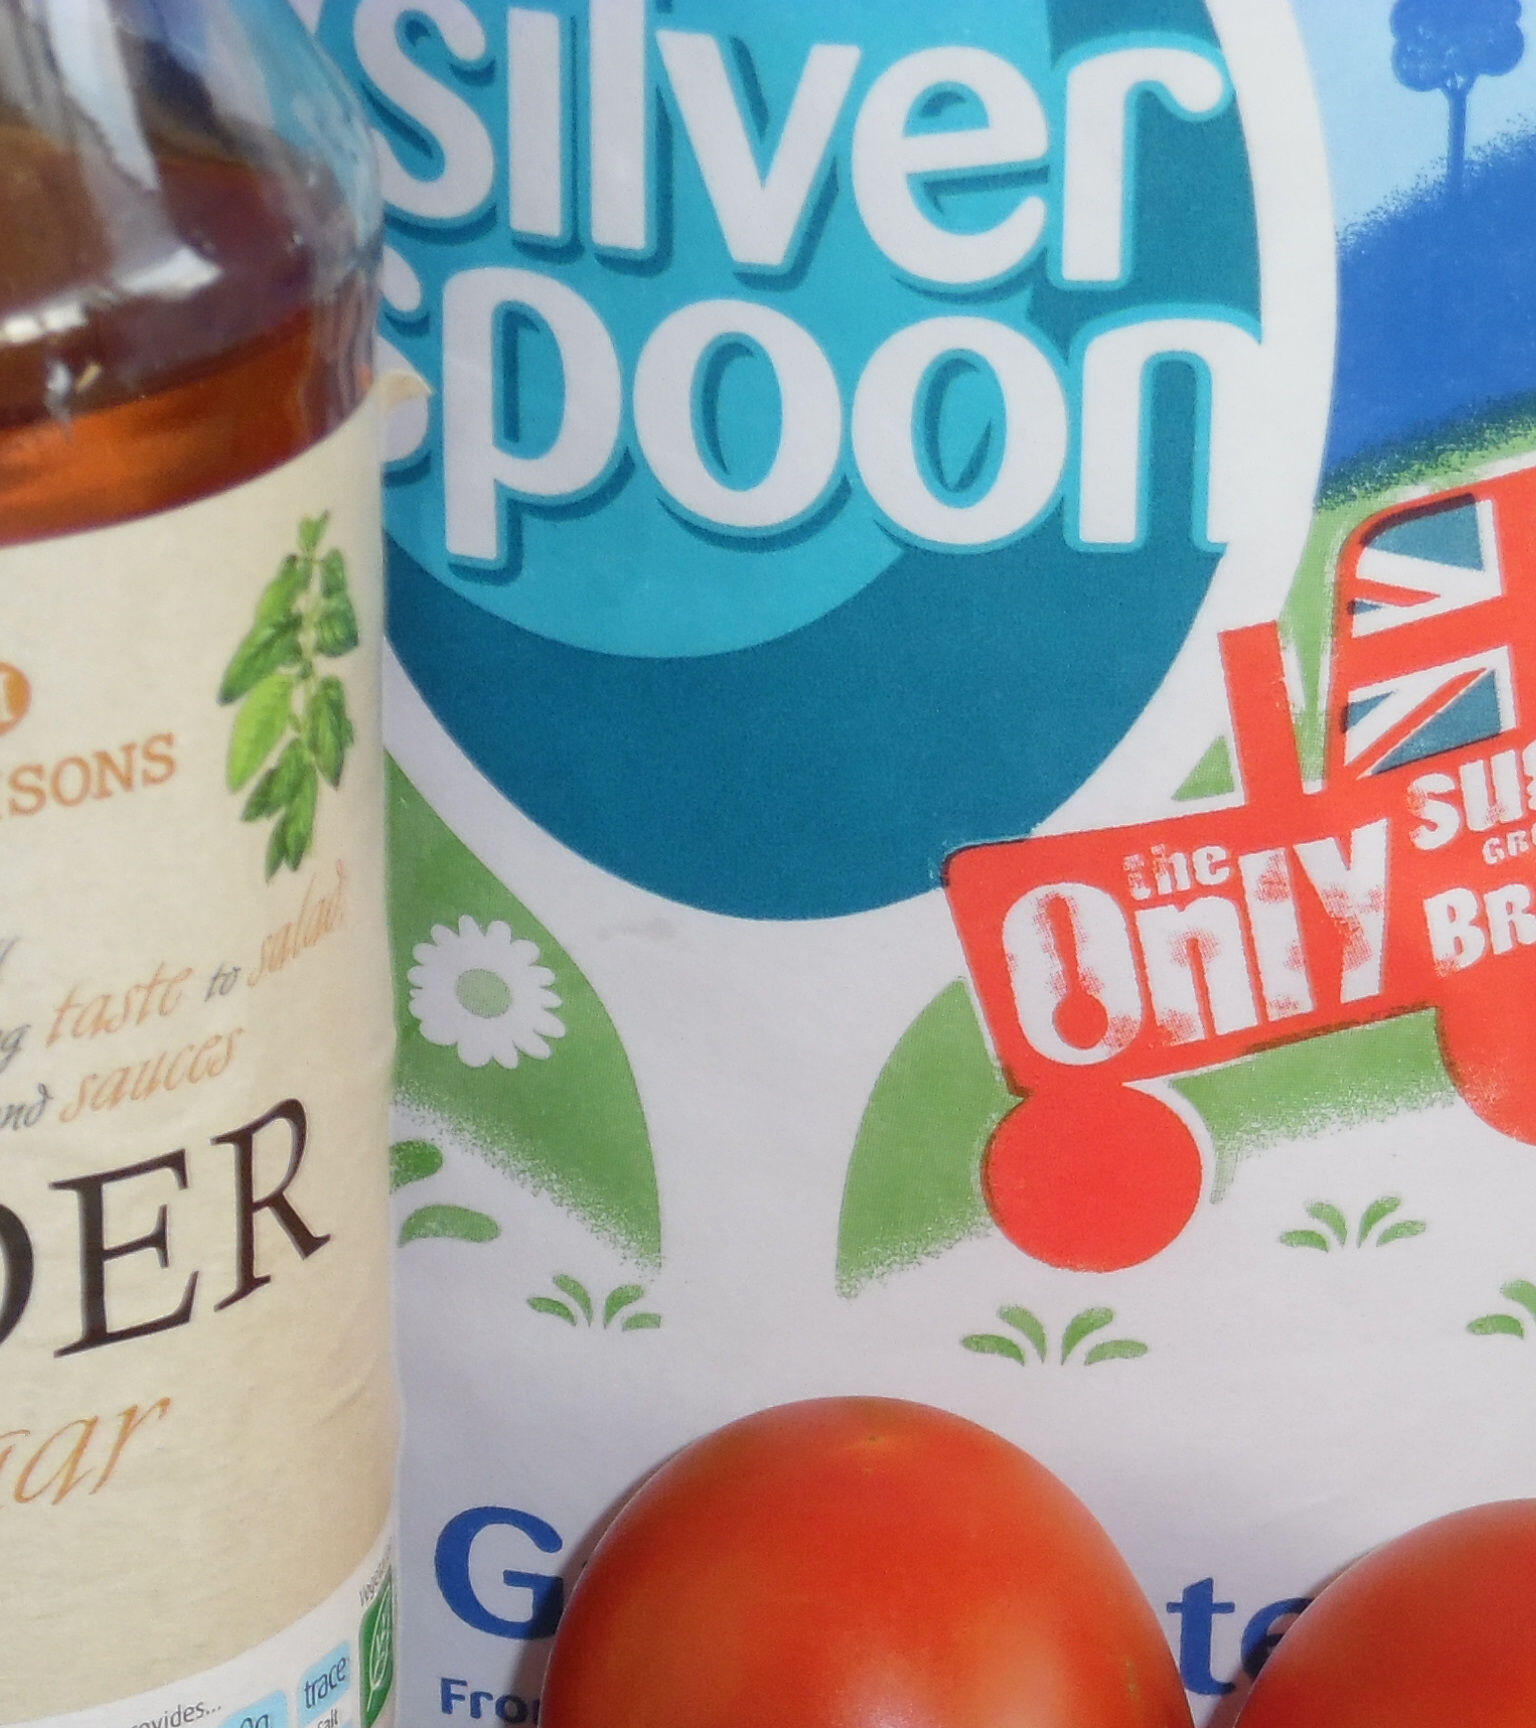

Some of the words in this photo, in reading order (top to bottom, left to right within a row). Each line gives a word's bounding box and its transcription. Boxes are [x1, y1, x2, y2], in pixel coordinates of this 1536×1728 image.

[1124, 843, 1231, 901] the
[45, 962, 193, 1048] taste
[204, 963, 242, 1002] to
[59, 1027, 245, 1122] sauces
[304, 1656, 347, 1710] trace
[440, 1676, 541, 1724] Fro
